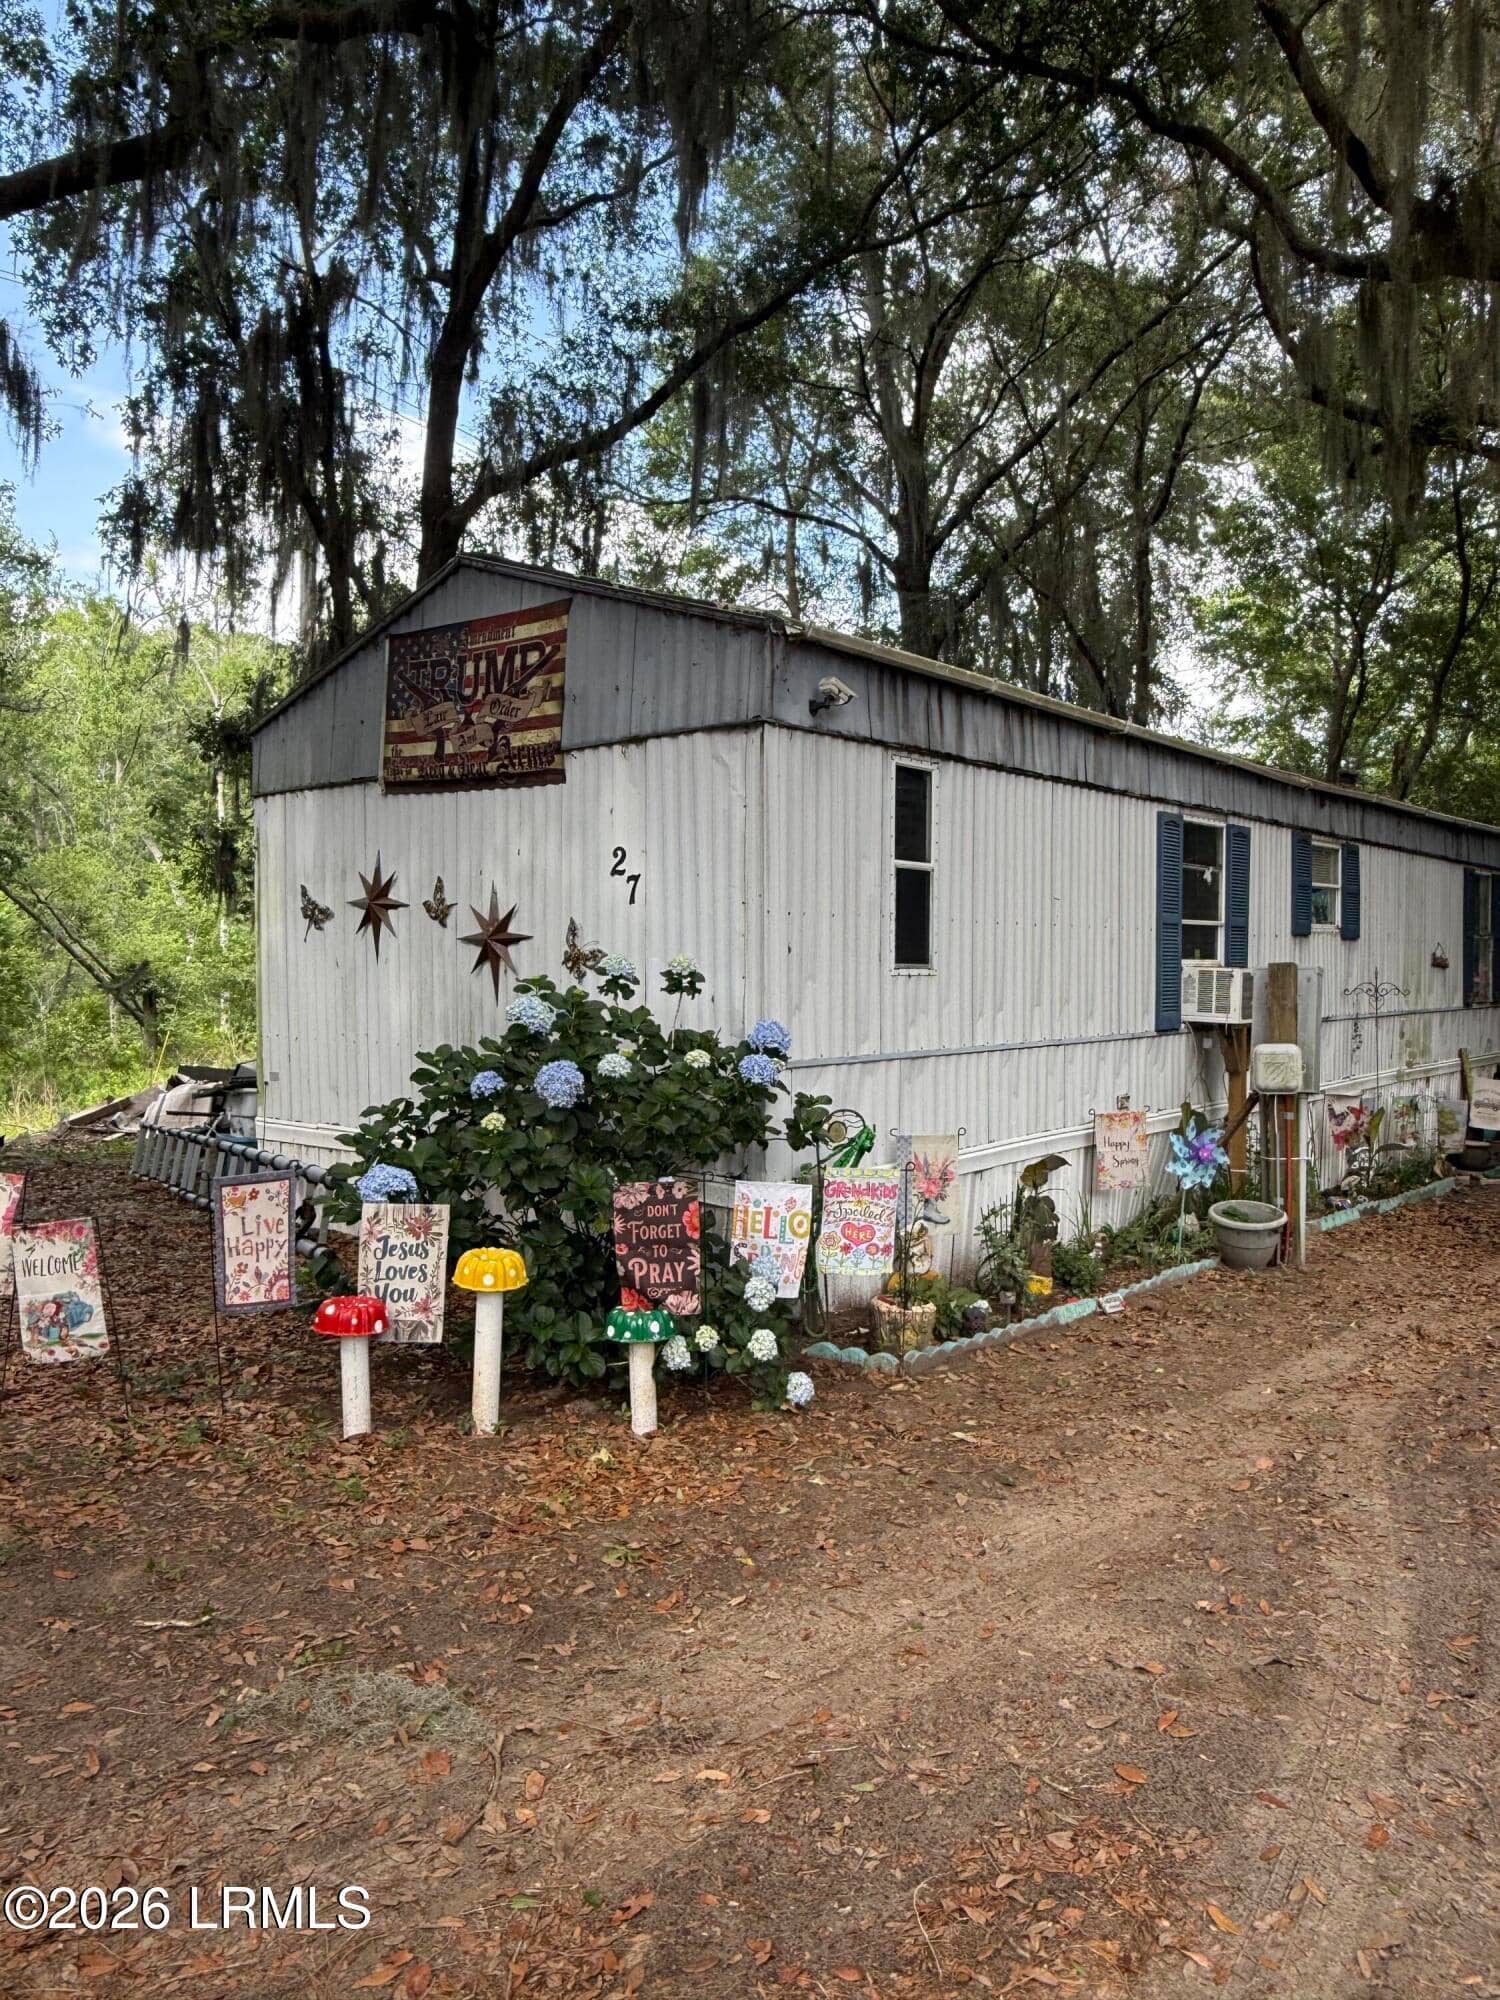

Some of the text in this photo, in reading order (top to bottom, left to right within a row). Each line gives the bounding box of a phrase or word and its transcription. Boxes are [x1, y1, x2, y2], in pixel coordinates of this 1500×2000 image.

[407, 639, 547, 701] TRUMP
[489, 697, 523, 719] Order
[241, 1214, 284, 1236] Live
[627, 1221, 681, 1243] FORGET
[731, 1205, 811, 1244] HELLO
[845, 1228, 872, 1241] HERE
[227, 1237, 288, 1262] Happy
[374, 1235, 429, 1260] Jesus
[652, 1244, 667, 1258] TO
[22, 1254, 80, 1277] WELCOME
[374, 1261, 427, 1283] Loves
[628, 1257, 685, 1289] PRAY
[375, 1283, 418, 1304] You
